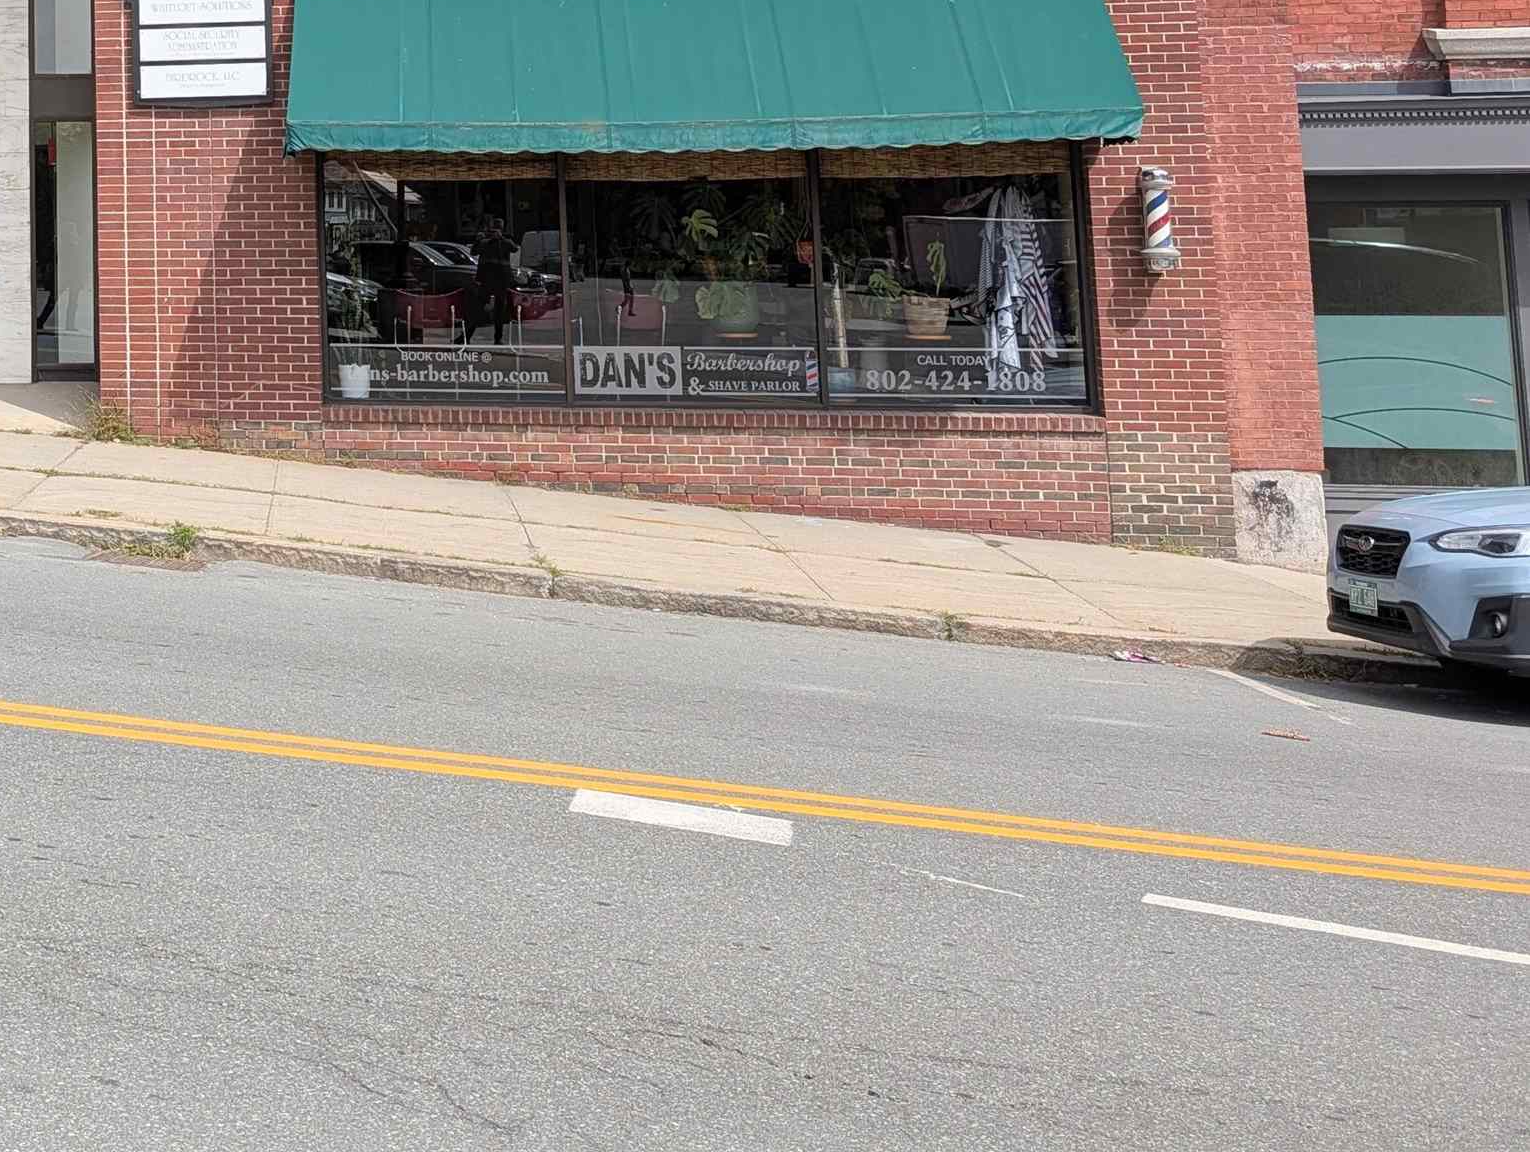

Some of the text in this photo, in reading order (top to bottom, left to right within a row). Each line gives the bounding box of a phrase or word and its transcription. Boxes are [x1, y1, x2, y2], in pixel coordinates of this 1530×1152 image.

[401, 351, 433, 362] BOOK
[435, 351, 479, 362] ONLINE
[917, 355, 991, 367] CALL TODAY
[349, 364, 550, 388] ns-barbershop.com
[579, 352, 801, 389] DAN'S Barbershop
[688, 377, 801, 395] & SHAVE PARLOR
